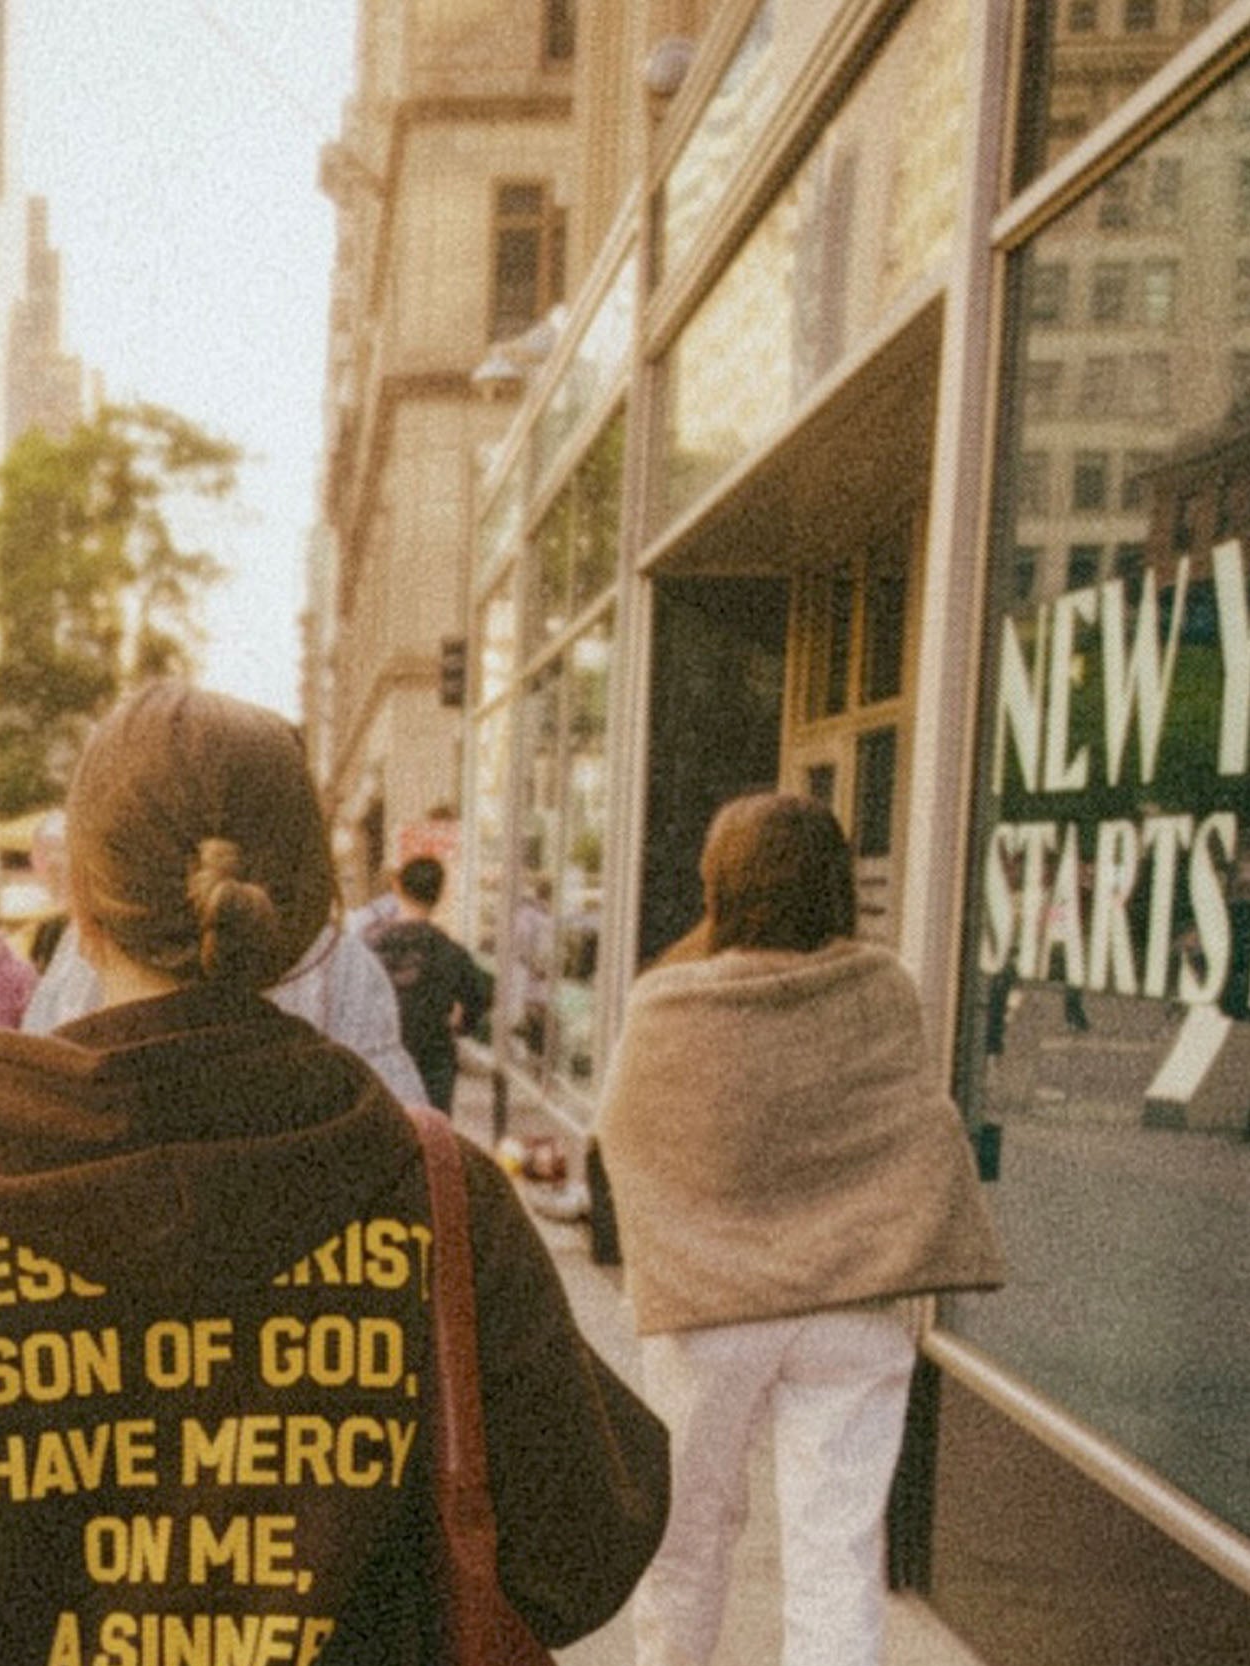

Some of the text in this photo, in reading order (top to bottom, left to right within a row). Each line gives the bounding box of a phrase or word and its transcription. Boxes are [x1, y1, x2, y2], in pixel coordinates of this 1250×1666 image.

[992, 555, 1190, 796] NEW
[979, 812, 1237, 1006] STARTS
[145, 1319, 233, 1388] OF
[260, 1315, 418, 1397] GOD,
[182, 1415, 417, 1486] MERCY
[83, 1515, 313, 1593] ON ME,
